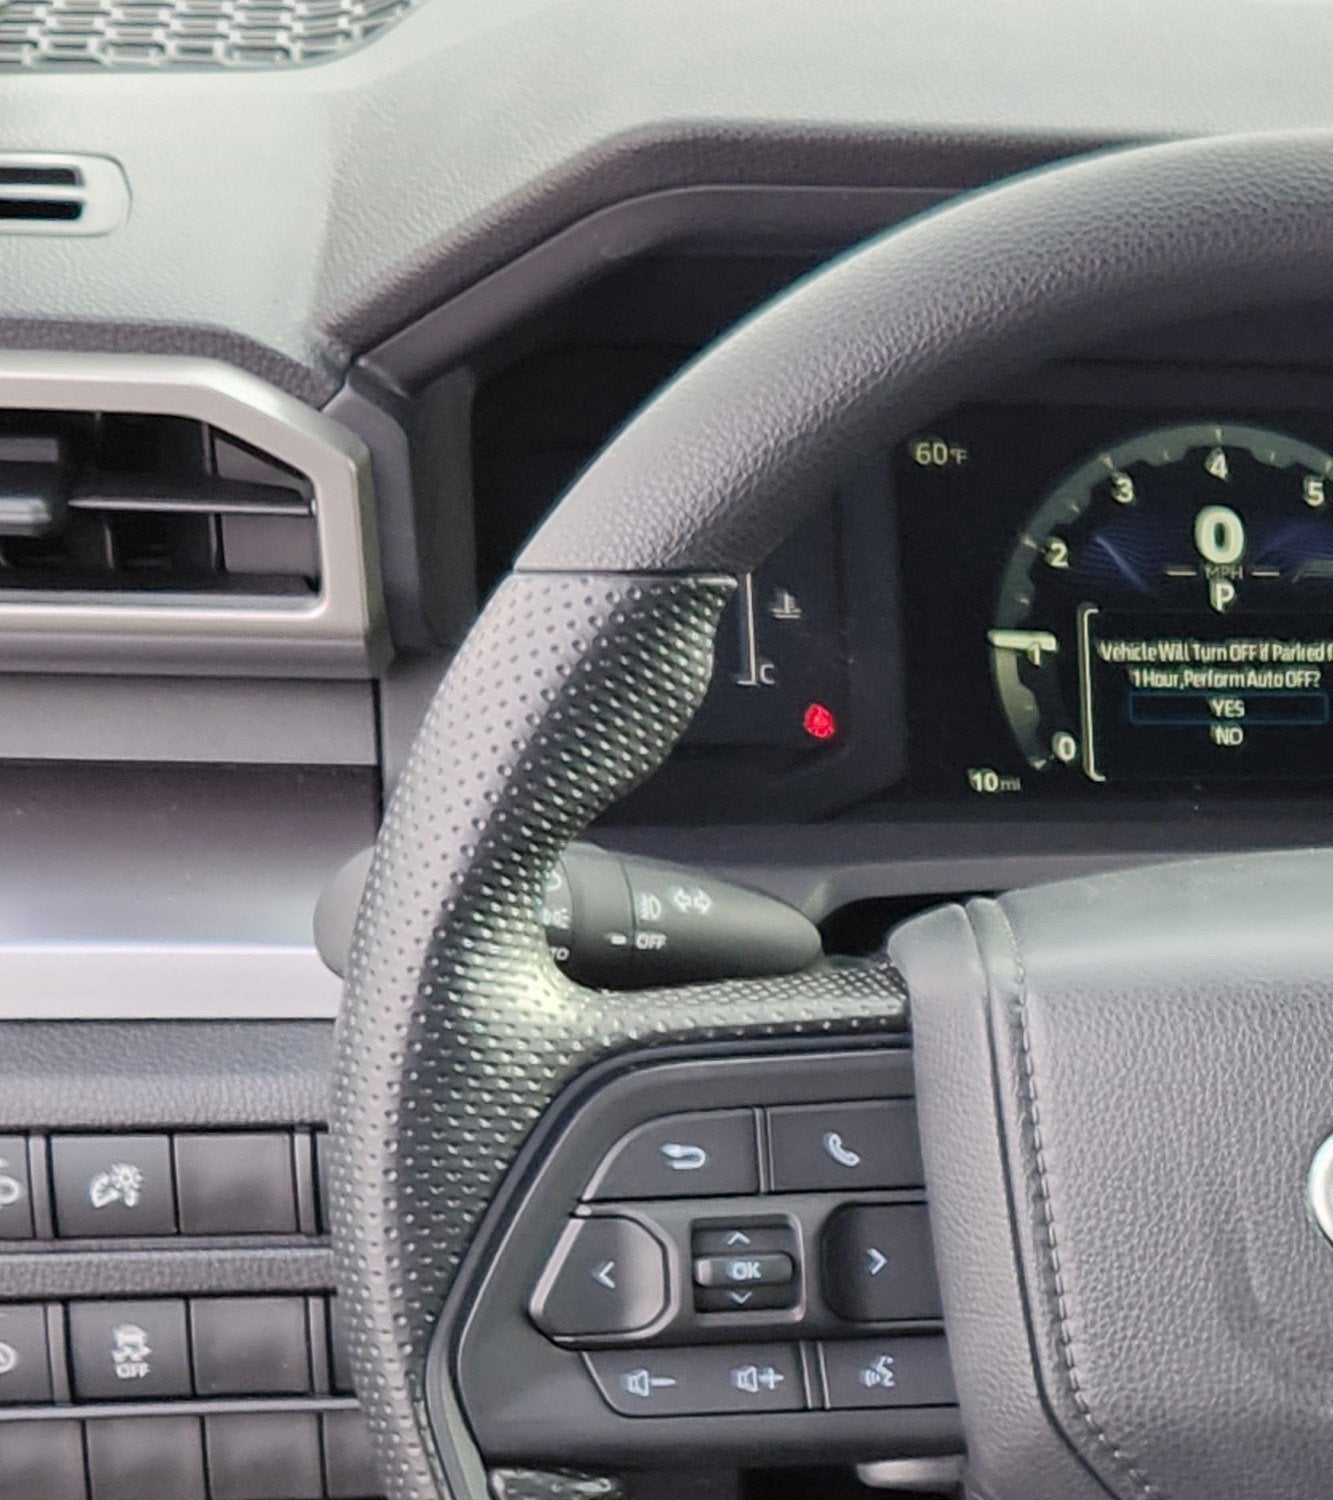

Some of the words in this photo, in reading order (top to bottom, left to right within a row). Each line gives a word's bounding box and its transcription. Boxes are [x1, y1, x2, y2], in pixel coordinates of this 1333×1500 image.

[1206, 449, 1229, 480] 4
[1112, 475, 1134, 503] 3
[1305, 478, 1325, 507] 5
[1195, 505, 1244, 564] 0
[1048, 540, 1069, 568] 2
[1211, 583, 1235, 612] P
[1099, 640, 1158, 662] Vehicle
[1211, 698, 1245, 717] YES
[1055, 733, 1076, 762] 0
[1213, 727, 1243, 746] NO
[635, 932, 667, 950] OFF
[730, 1260, 761, 1280] OK
